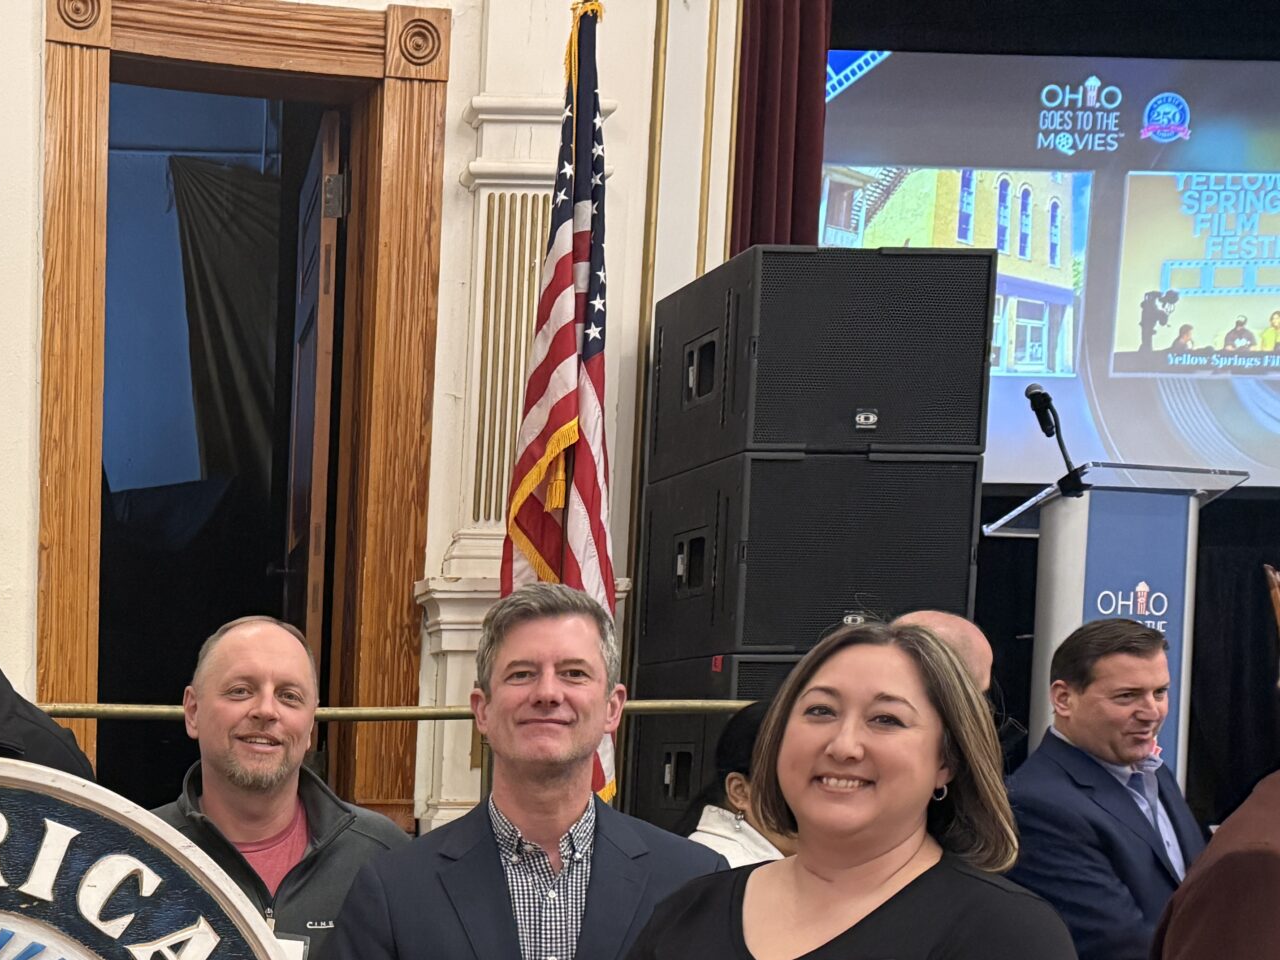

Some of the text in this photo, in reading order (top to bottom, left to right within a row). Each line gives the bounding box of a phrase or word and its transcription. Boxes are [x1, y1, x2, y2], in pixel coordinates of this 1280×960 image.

[1039, 110, 1120, 131] GOES TO THE
[1150, 110, 1184, 126] 250
[1037, 132, 1119, 156] MOVIES
[1193, 213, 1260, 237] FILM
[1167, 353, 1208, 366] Yellow
[1211, 353, 1261, 369] Springs
